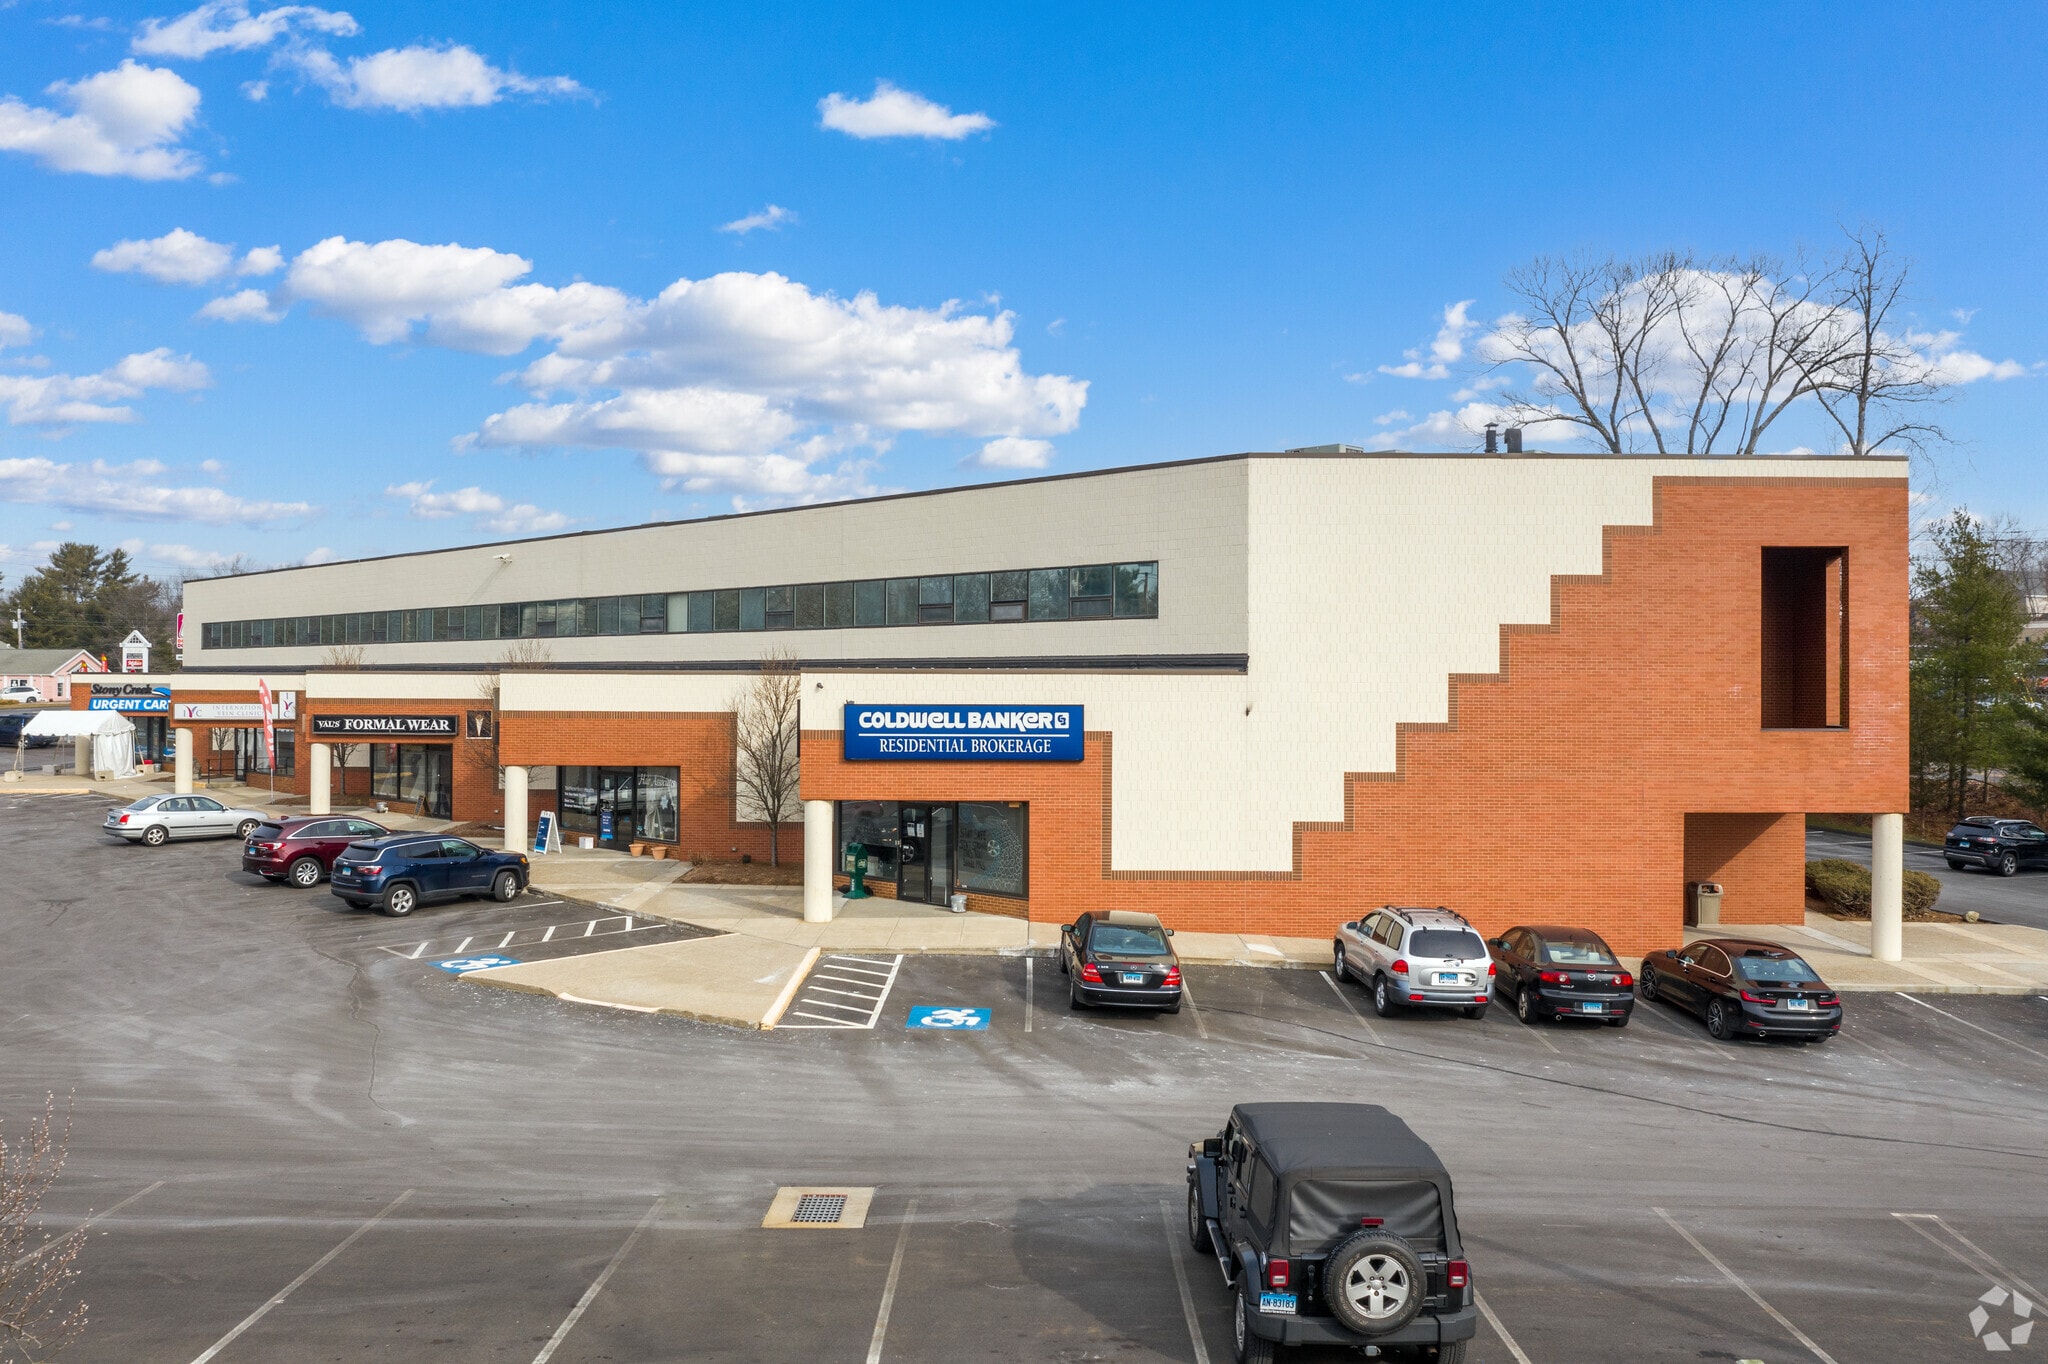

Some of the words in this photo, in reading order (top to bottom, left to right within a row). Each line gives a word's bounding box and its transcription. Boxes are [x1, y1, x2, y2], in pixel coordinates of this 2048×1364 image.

[91, 683, 122, 697] Stony
[123, 683, 153, 695] Creek
[92, 699, 141, 710] URGENT
[343, 718, 405, 731] FORMAL
[405, 718, 452, 731] WEAR
[859, 711, 966, 729] COLDWELL
[967, 711, 1054, 732] BANKER
[879, 738, 968, 753] RESIDENTIAL
[971, 738, 1052, 753] BROKERAGE
